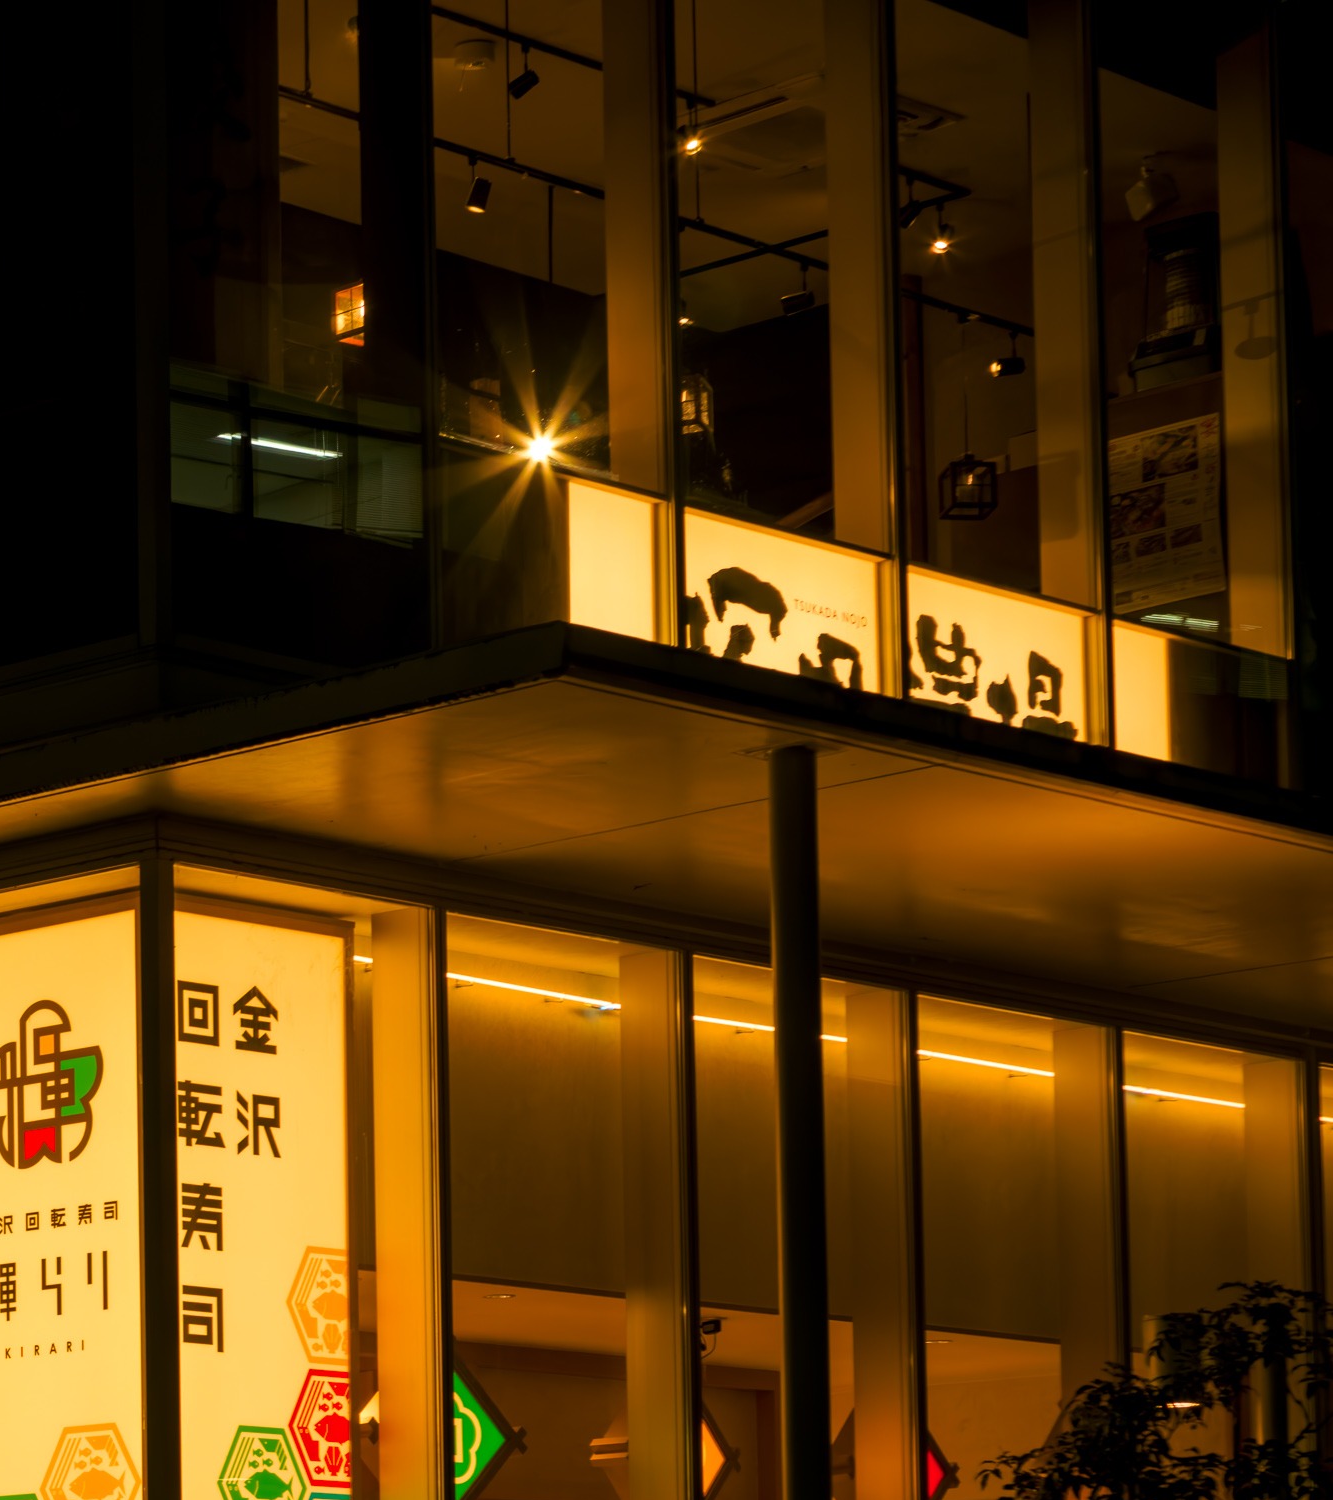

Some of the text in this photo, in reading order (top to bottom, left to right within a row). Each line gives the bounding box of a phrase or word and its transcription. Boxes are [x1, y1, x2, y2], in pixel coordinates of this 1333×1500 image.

[793, 598, 839, 622] TSUKADA
[232, 985, 282, 1159] 金沢
[177, 979, 226, 1353] 回転寿司
[4, 1339, 86, 1360] KIRARI
